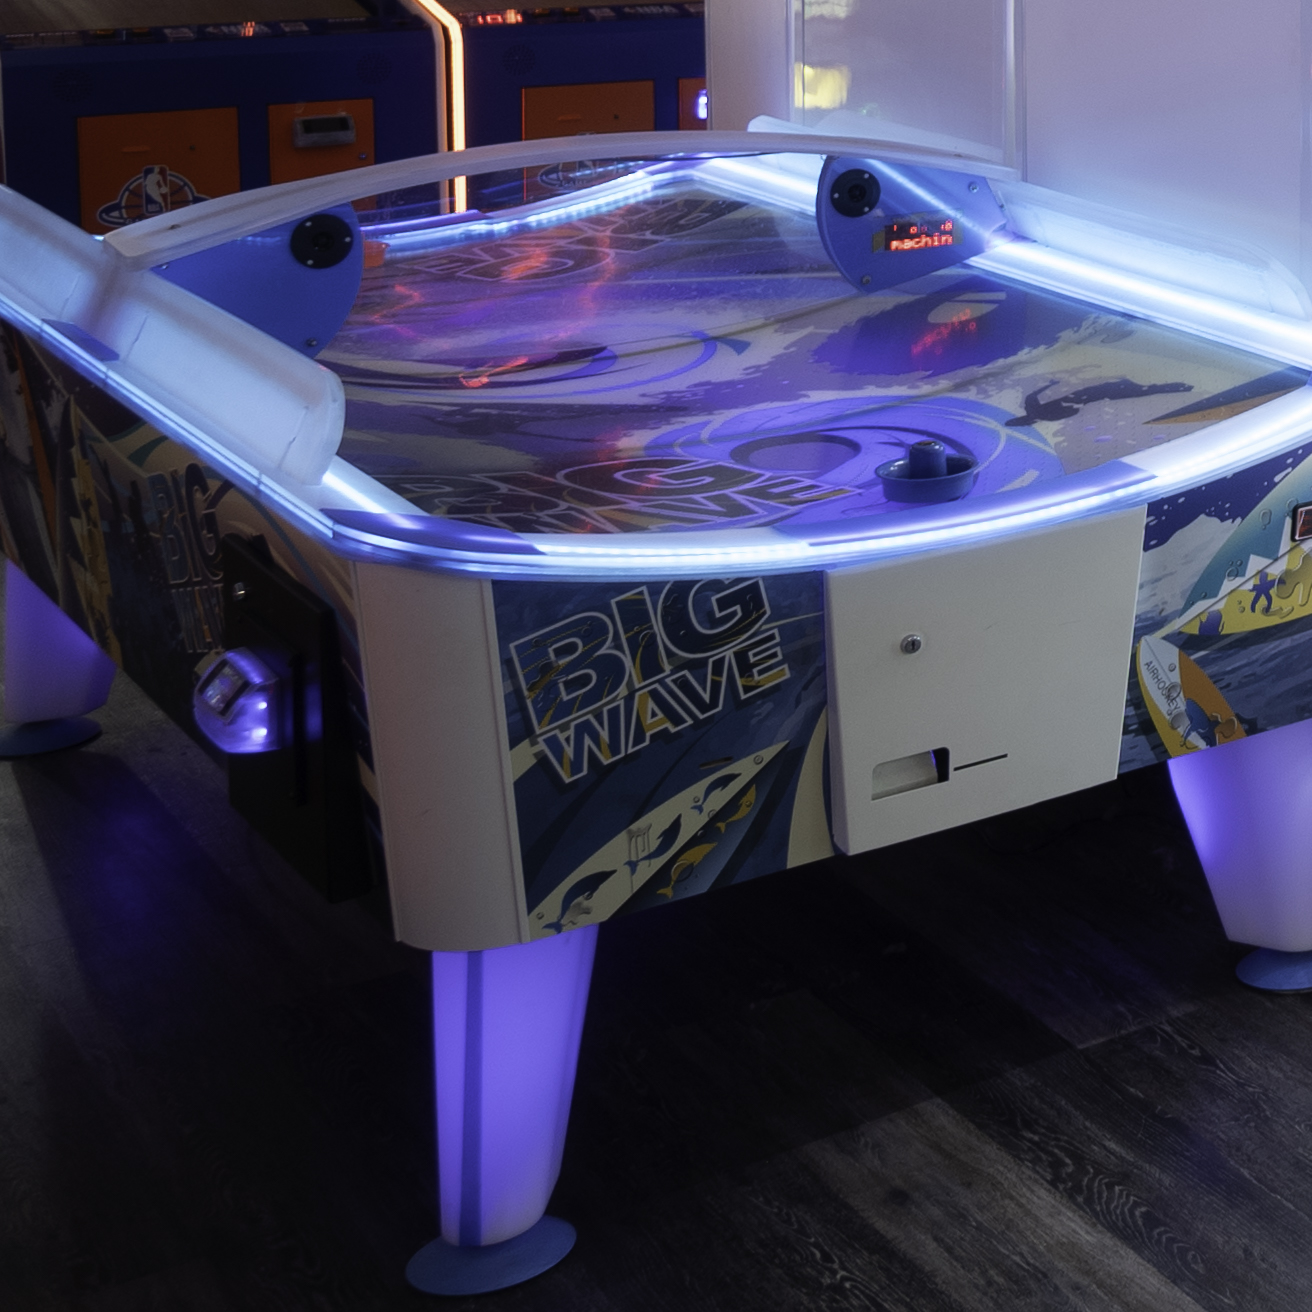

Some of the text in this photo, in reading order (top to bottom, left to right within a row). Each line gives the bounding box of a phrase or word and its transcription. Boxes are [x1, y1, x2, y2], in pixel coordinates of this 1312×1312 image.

[889, 232, 954, 252] machin
[509, 578, 771, 732] BIG
[537, 627, 792, 784] WAVE
[1143, 660, 1182, 712] AIRHOCKEY
